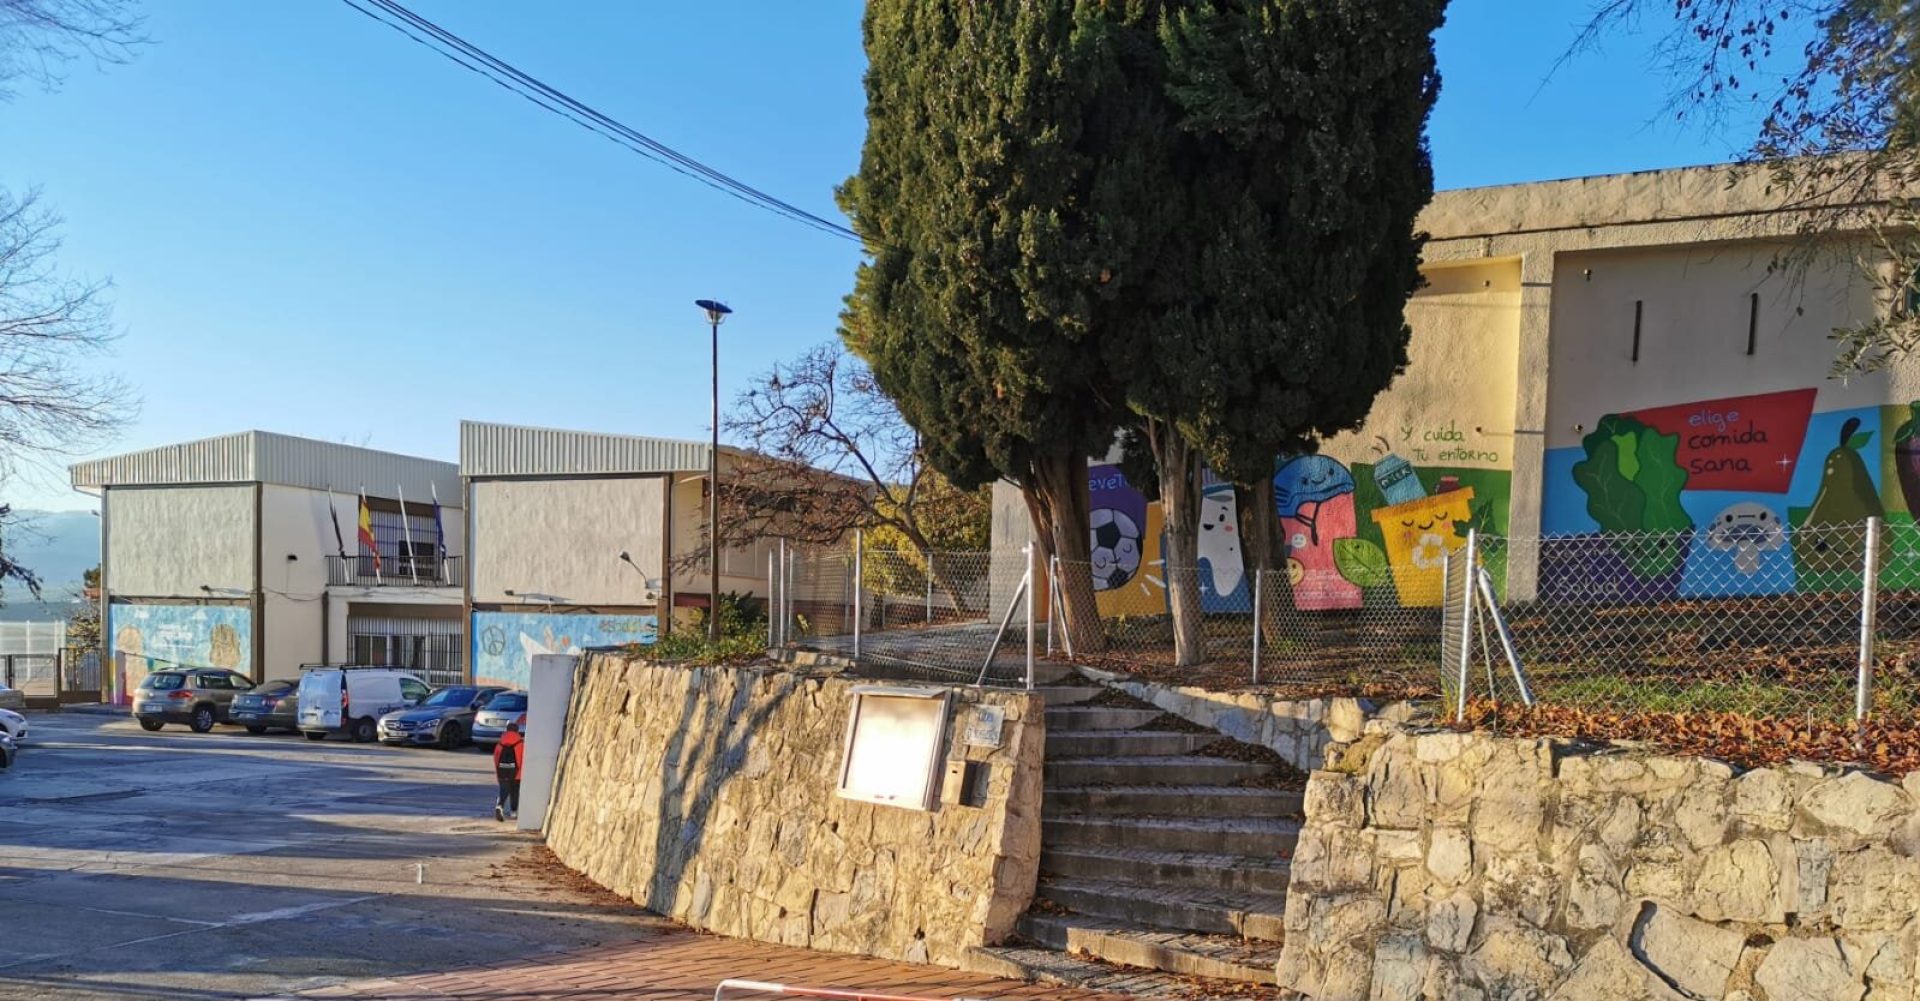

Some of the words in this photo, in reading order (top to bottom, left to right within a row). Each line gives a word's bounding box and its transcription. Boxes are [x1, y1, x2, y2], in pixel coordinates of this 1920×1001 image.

[1423, 419, 1465, 441] cuida
[1689, 410, 1740, 432] elige
[1688, 420, 1768, 450] comida
[1690, 457, 1752, 475] sana
